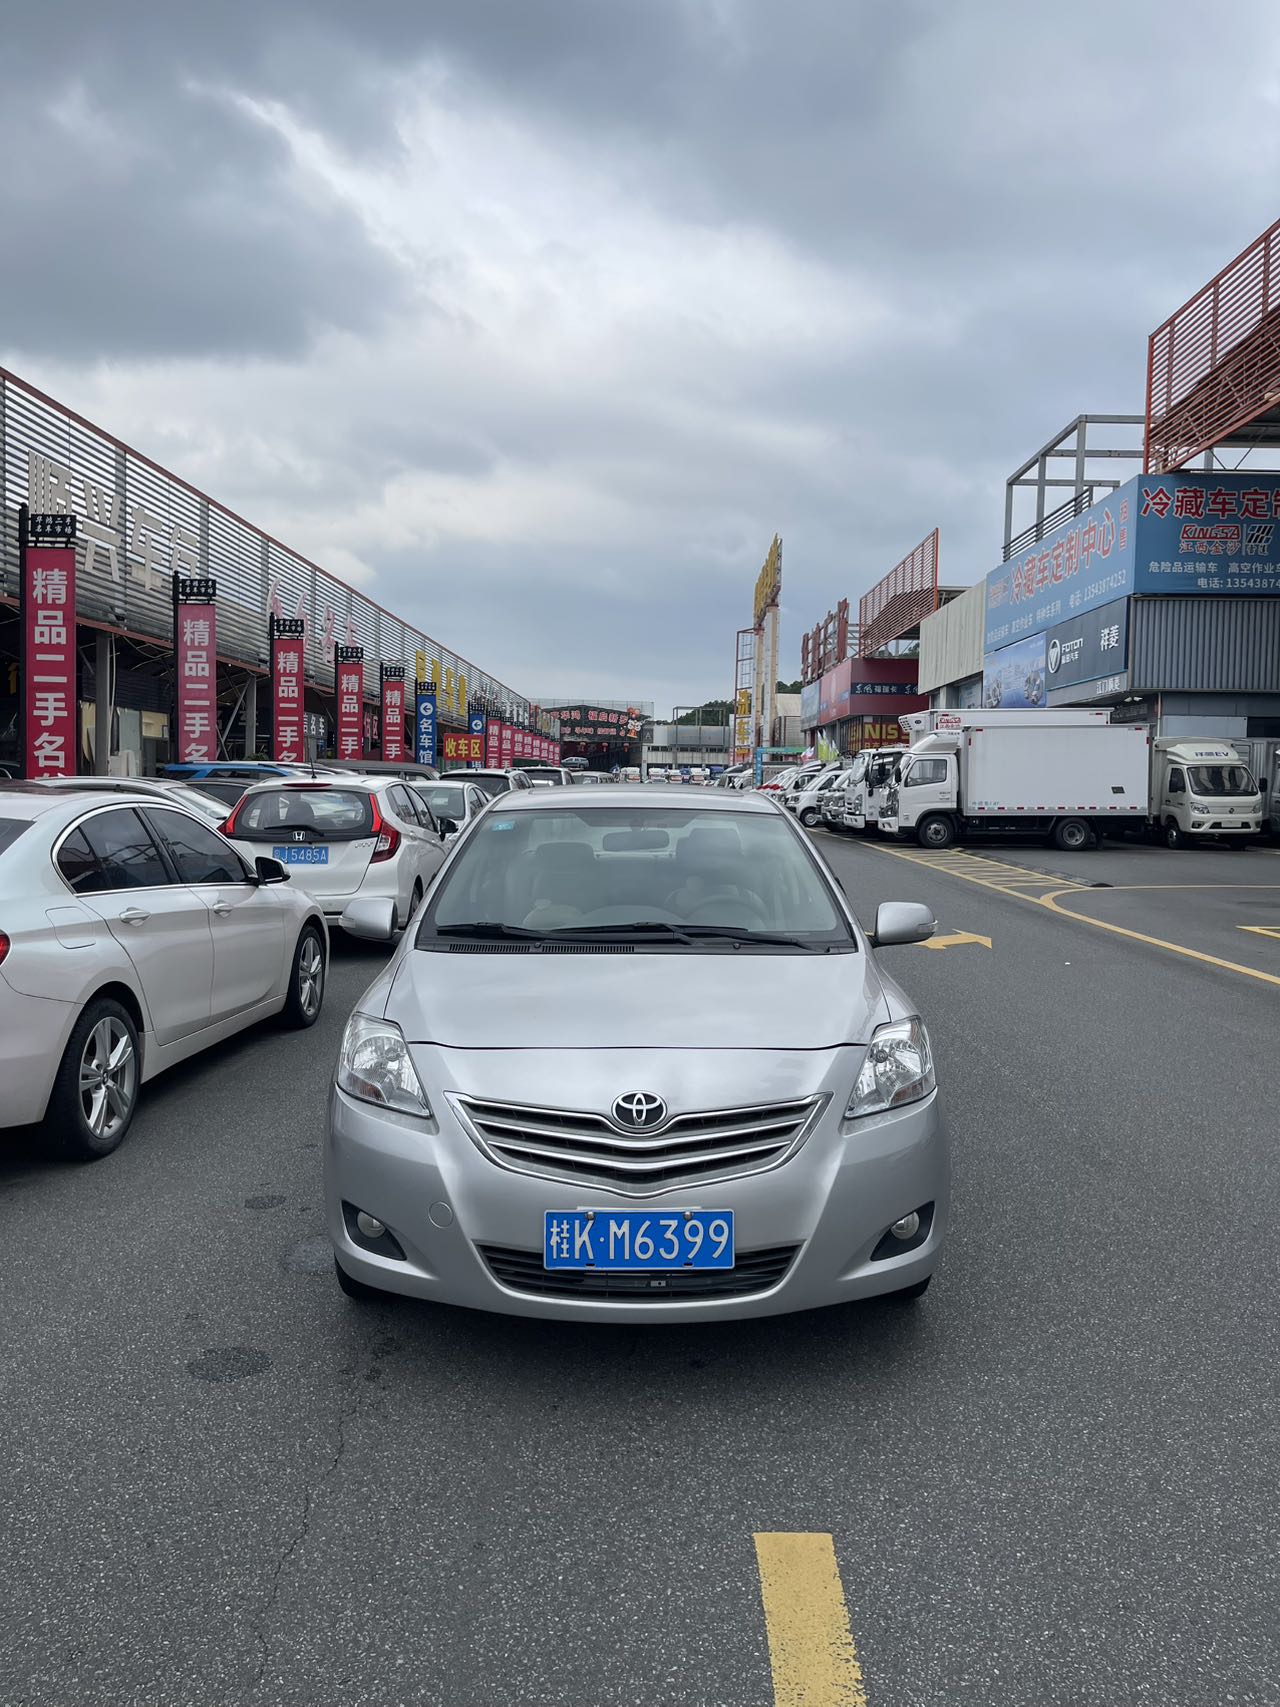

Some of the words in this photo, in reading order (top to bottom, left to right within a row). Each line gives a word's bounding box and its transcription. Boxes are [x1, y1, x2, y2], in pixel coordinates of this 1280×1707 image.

[1010, 508, 1116, 605] 冷藏车定制中心
[1148, 561, 1218, 574] 危险品运输车
[1061, 637, 1084, 653] FOTON
[33, 568, 68, 780] 精品二手名
[341, 674, 359, 760] 精品二手
[385, 690, 401, 758] 精品二手
[864, 723, 909, 739] NIS
[419, 718, 433, 764] 名车馆
[445, 738, 481, 757] 收车区
[550, 1219, 729, 1260] 桂K·M6399
